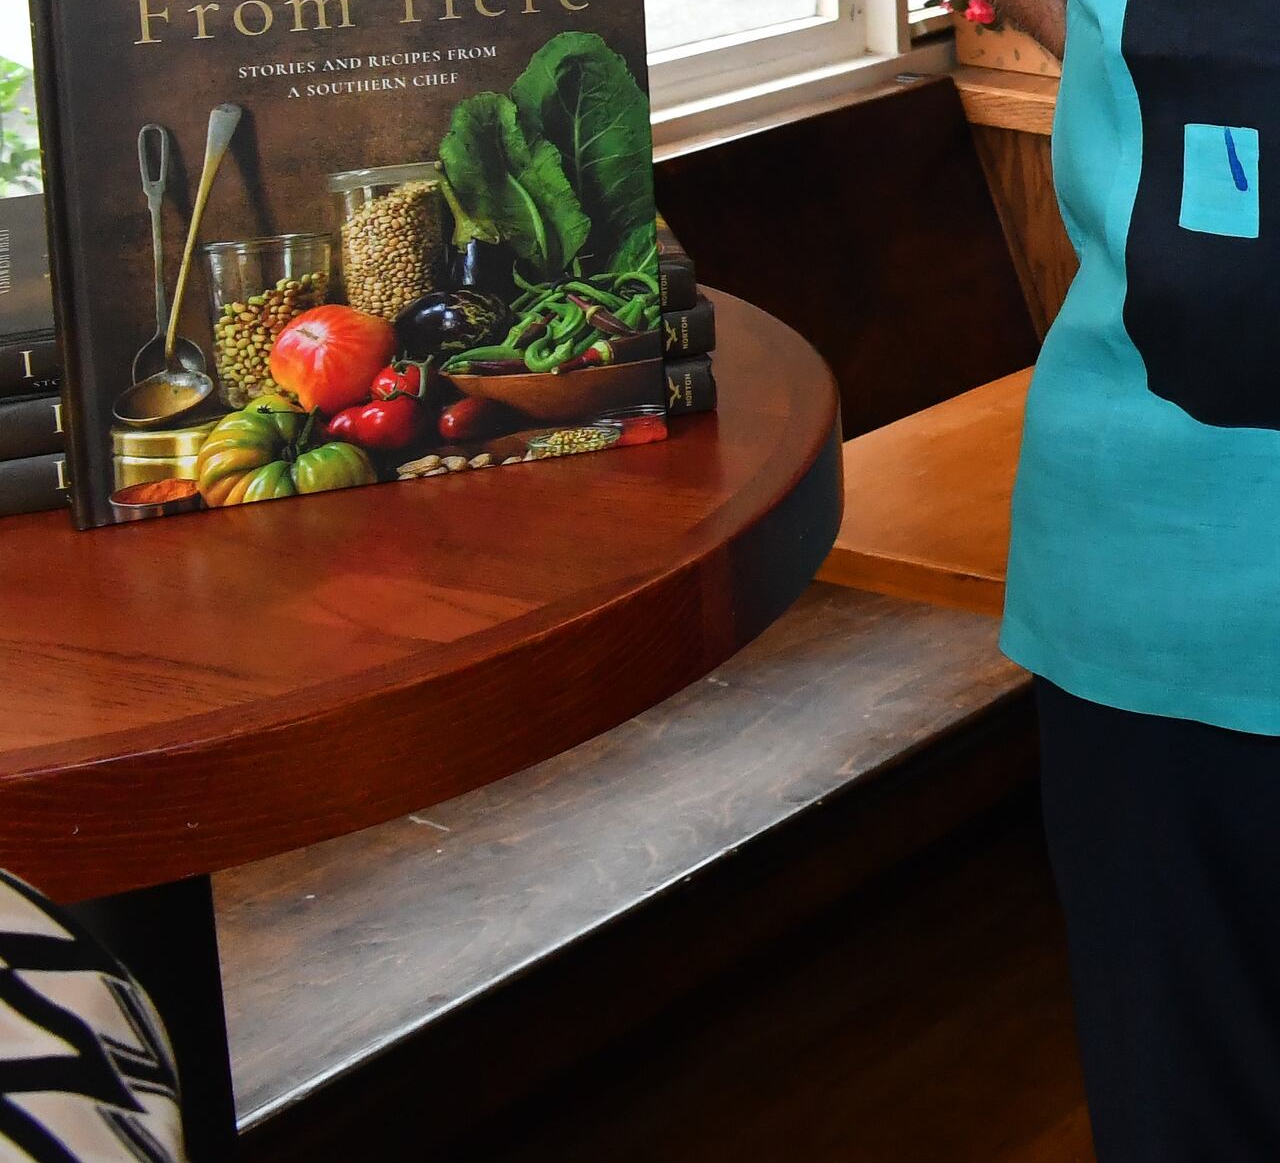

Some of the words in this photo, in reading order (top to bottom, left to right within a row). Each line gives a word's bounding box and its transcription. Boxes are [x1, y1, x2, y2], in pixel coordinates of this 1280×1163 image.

[238, 62, 316, 79] STORIES
[322, 57, 362, 72] AND
[368, 51, 441, 68] RECIPES
[447, 45, 497, 61] FROM
[287, 86, 300, 99] A
[306, 76, 407, 97] SOUTHERN
[412, 72, 459, 87] CHEF
[20, 350, 33, 378] I
[684, 373, 692, 407] NORTON
[53, 460, 67, 490] I
